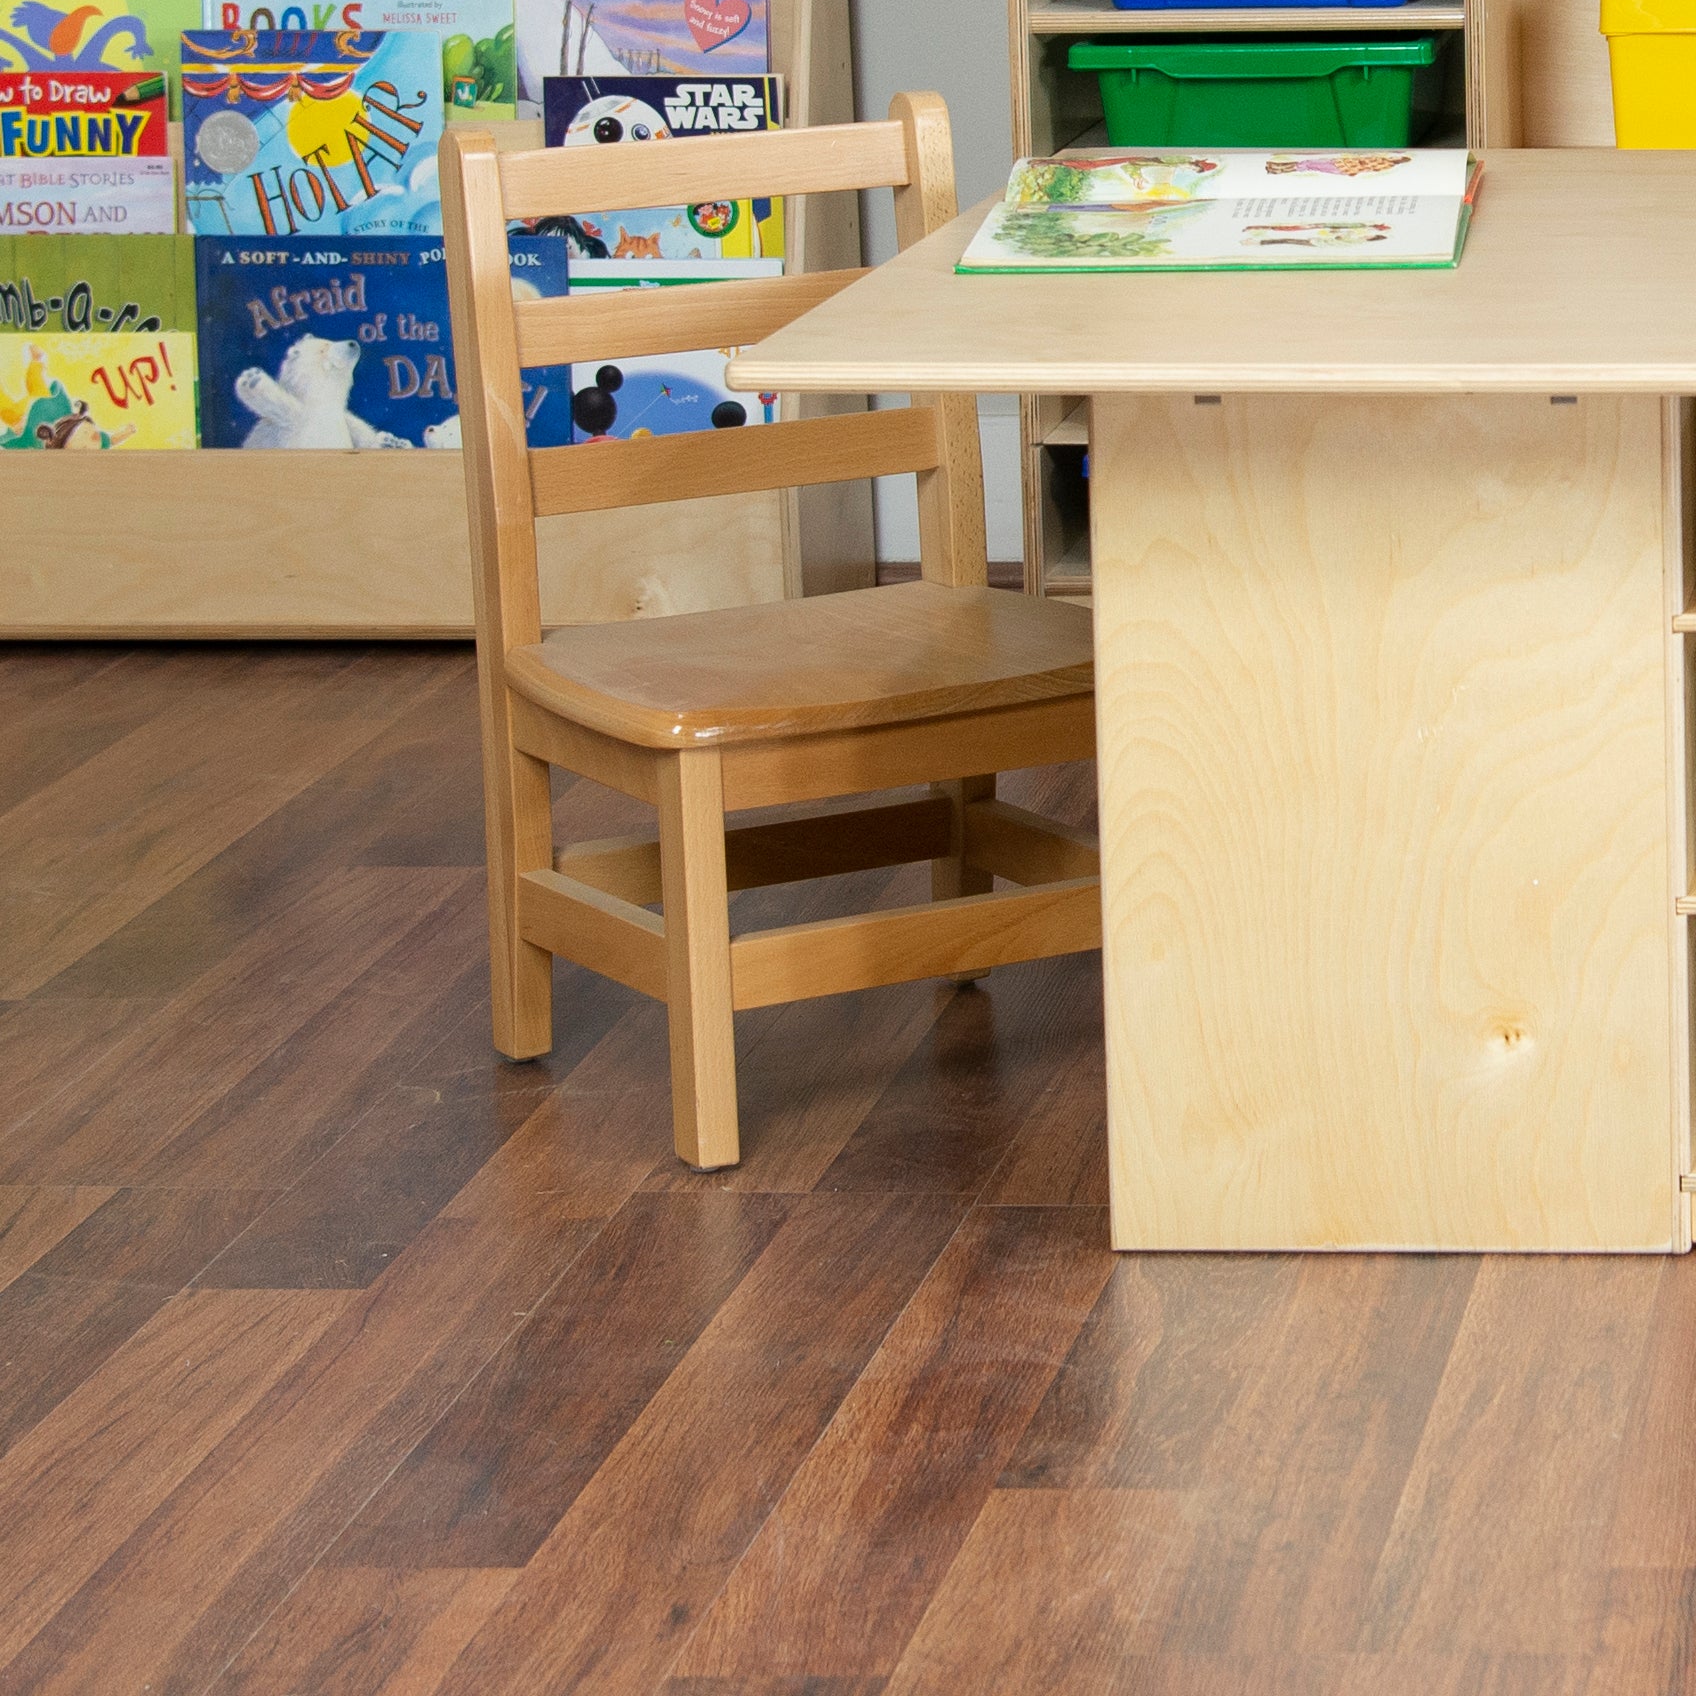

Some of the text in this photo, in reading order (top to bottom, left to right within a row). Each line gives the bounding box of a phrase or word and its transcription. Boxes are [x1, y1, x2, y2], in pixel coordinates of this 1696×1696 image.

[383, 13, 458, 24] MELISSA SWEET
[19, 75, 43, 104] to
[49, 80, 111, 104] Draw
[664, 84, 763, 107] STAR
[665, 106, 763, 131] WARS
[1, 109, 146, 156] FUNNY
[248, 81, 428, 236] HOT AIR
[20, 173, 66, 188] BIBLE
[69, 172, 135, 189] STORIES
[83, 205, 129, 223] AND
[221, 252, 236, 265] A
[239, 252, 289, 265] SOFT
[351, 252, 410, 266] SHINY
[247, 273, 367, 338] Afraid
[358, 313, 439, 342] of the
[91, 341, 177, 409] UP!
